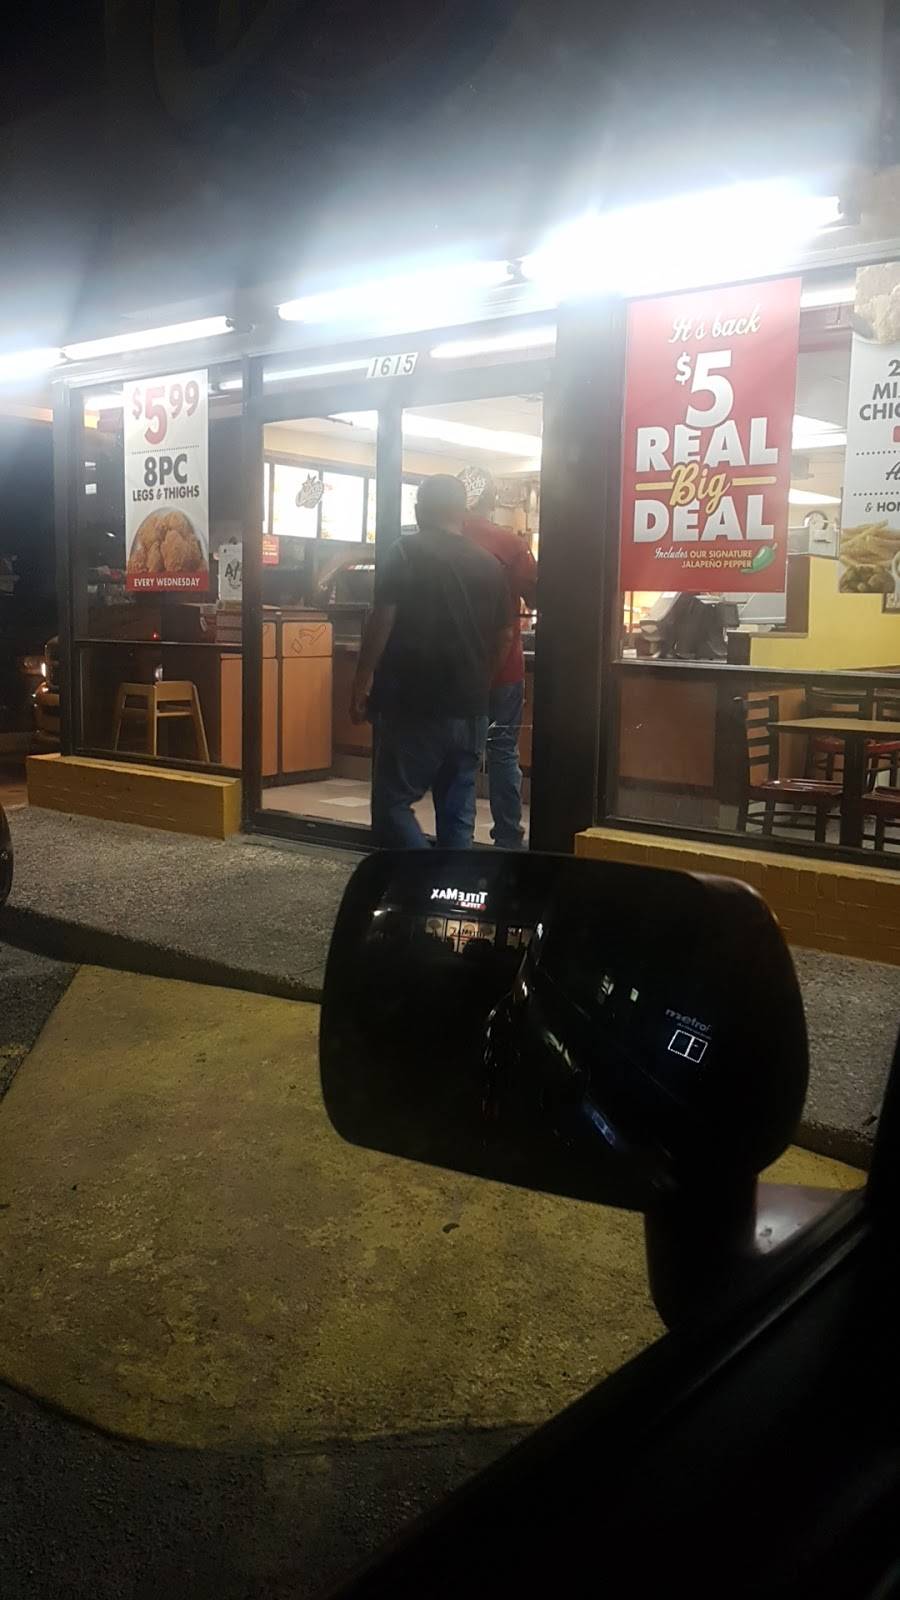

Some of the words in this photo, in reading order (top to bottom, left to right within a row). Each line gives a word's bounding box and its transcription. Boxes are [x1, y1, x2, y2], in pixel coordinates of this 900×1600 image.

[667, 314, 707, 344] It's
[712, 304, 762, 338] back
[371, 354, 415, 377] 1615
[675, 349, 734, 429] $5
[872, 381, 900, 401] MI
[636, 417, 779, 473] REAL
[143, 453, 188, 488] 8PC
[132, 488, 154, 502] LEGS
[164, 484, 200, 500] THIGHS
[669, 461, 731, 515] Big
[633, 494, 775, 543] DEAL
[654, 546, 688, 560] Includes
[689, 550, 707, 559] OUR
[708, 549, 753, 559] SIGNATURE
[723, 560, 752, 568] PEPPER
[133, 577, 154, 587] EVERY
[156, 577, 201, 587] WEDNESDAY
